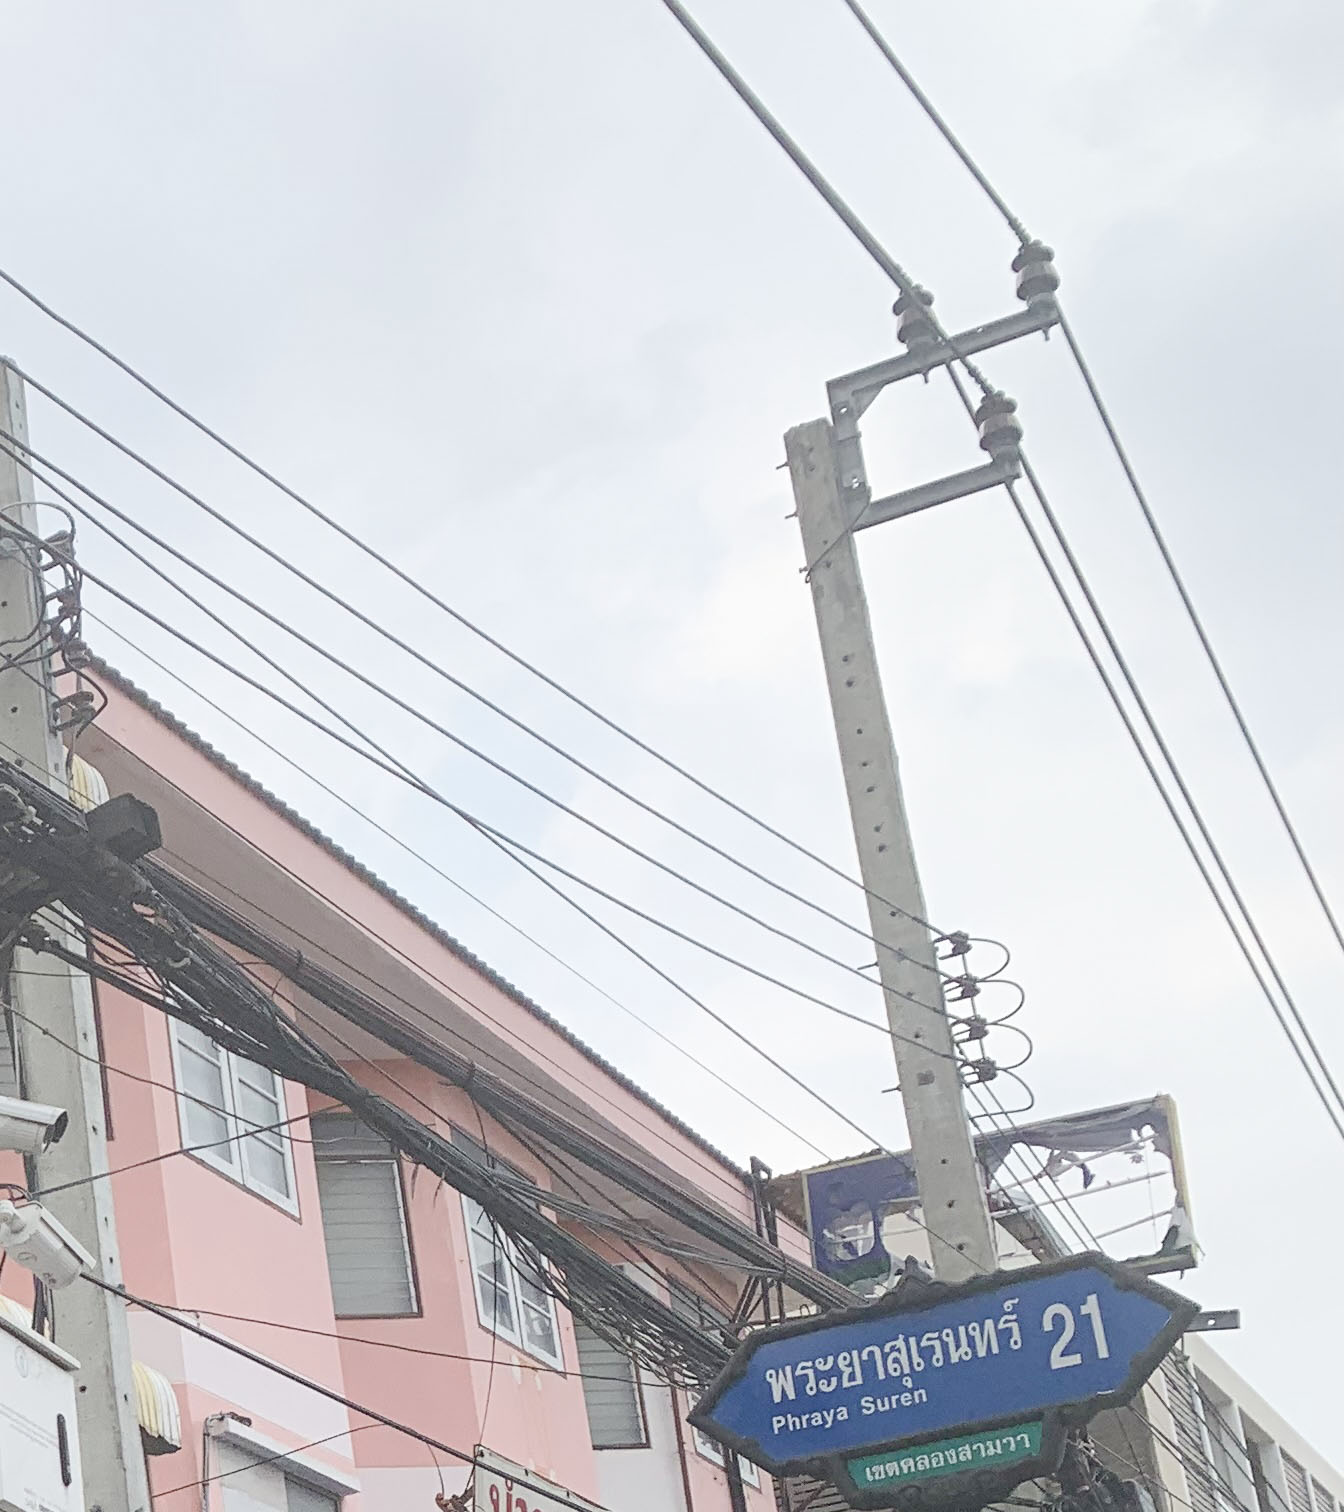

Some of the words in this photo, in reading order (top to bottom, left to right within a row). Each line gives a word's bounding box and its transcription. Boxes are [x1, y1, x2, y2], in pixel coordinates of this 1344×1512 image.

[765, 1297, 1023, 1404] พระยาสุเรนทร์
[1042, 1293, 1110, 1371] 21
[772, 1404, 849, 1435] Phraya
[860, 1387, 928, 1416] Suren
[865, 1433, 1031, 1482] เขตคลองสามวา
